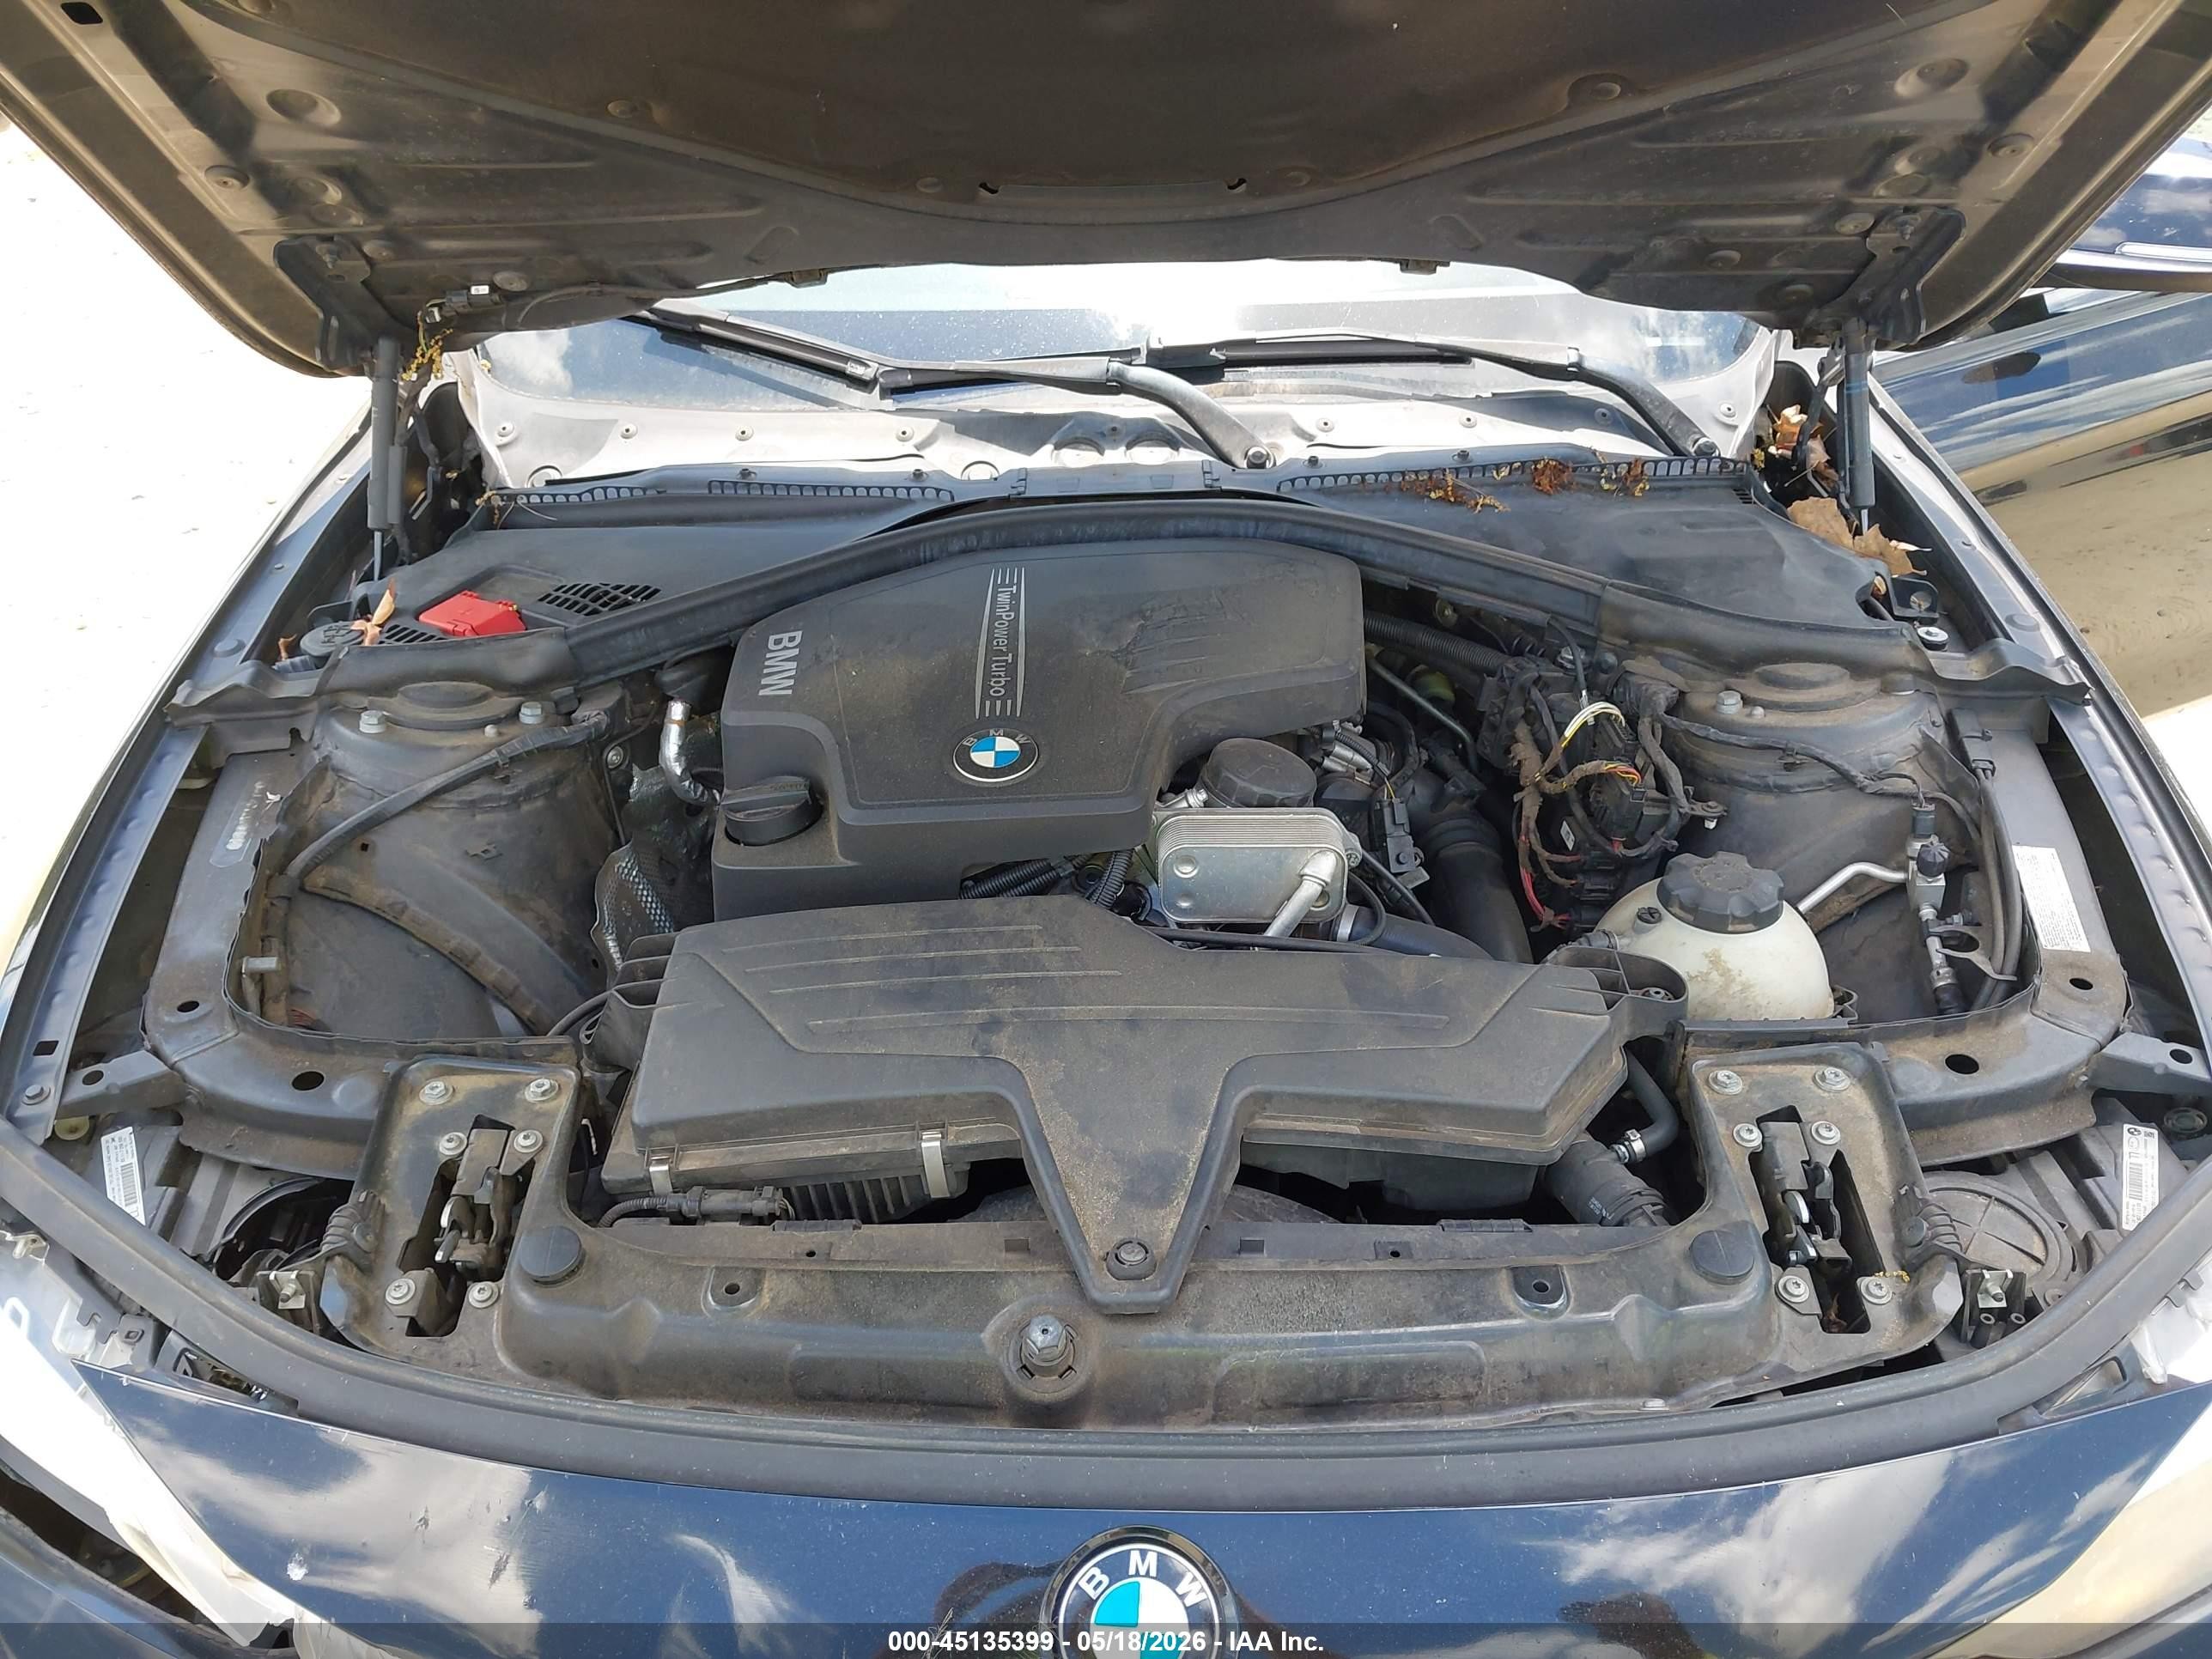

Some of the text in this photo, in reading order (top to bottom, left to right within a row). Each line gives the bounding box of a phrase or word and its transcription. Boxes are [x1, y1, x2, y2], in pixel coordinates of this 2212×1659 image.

[758, 630, 803, 696] BMW
[988, 585, 1018, 697] TwinPower Turbo
[961, 728, 1031, 747] BMW
[1078, 1549, 1208, 1608] BMW
